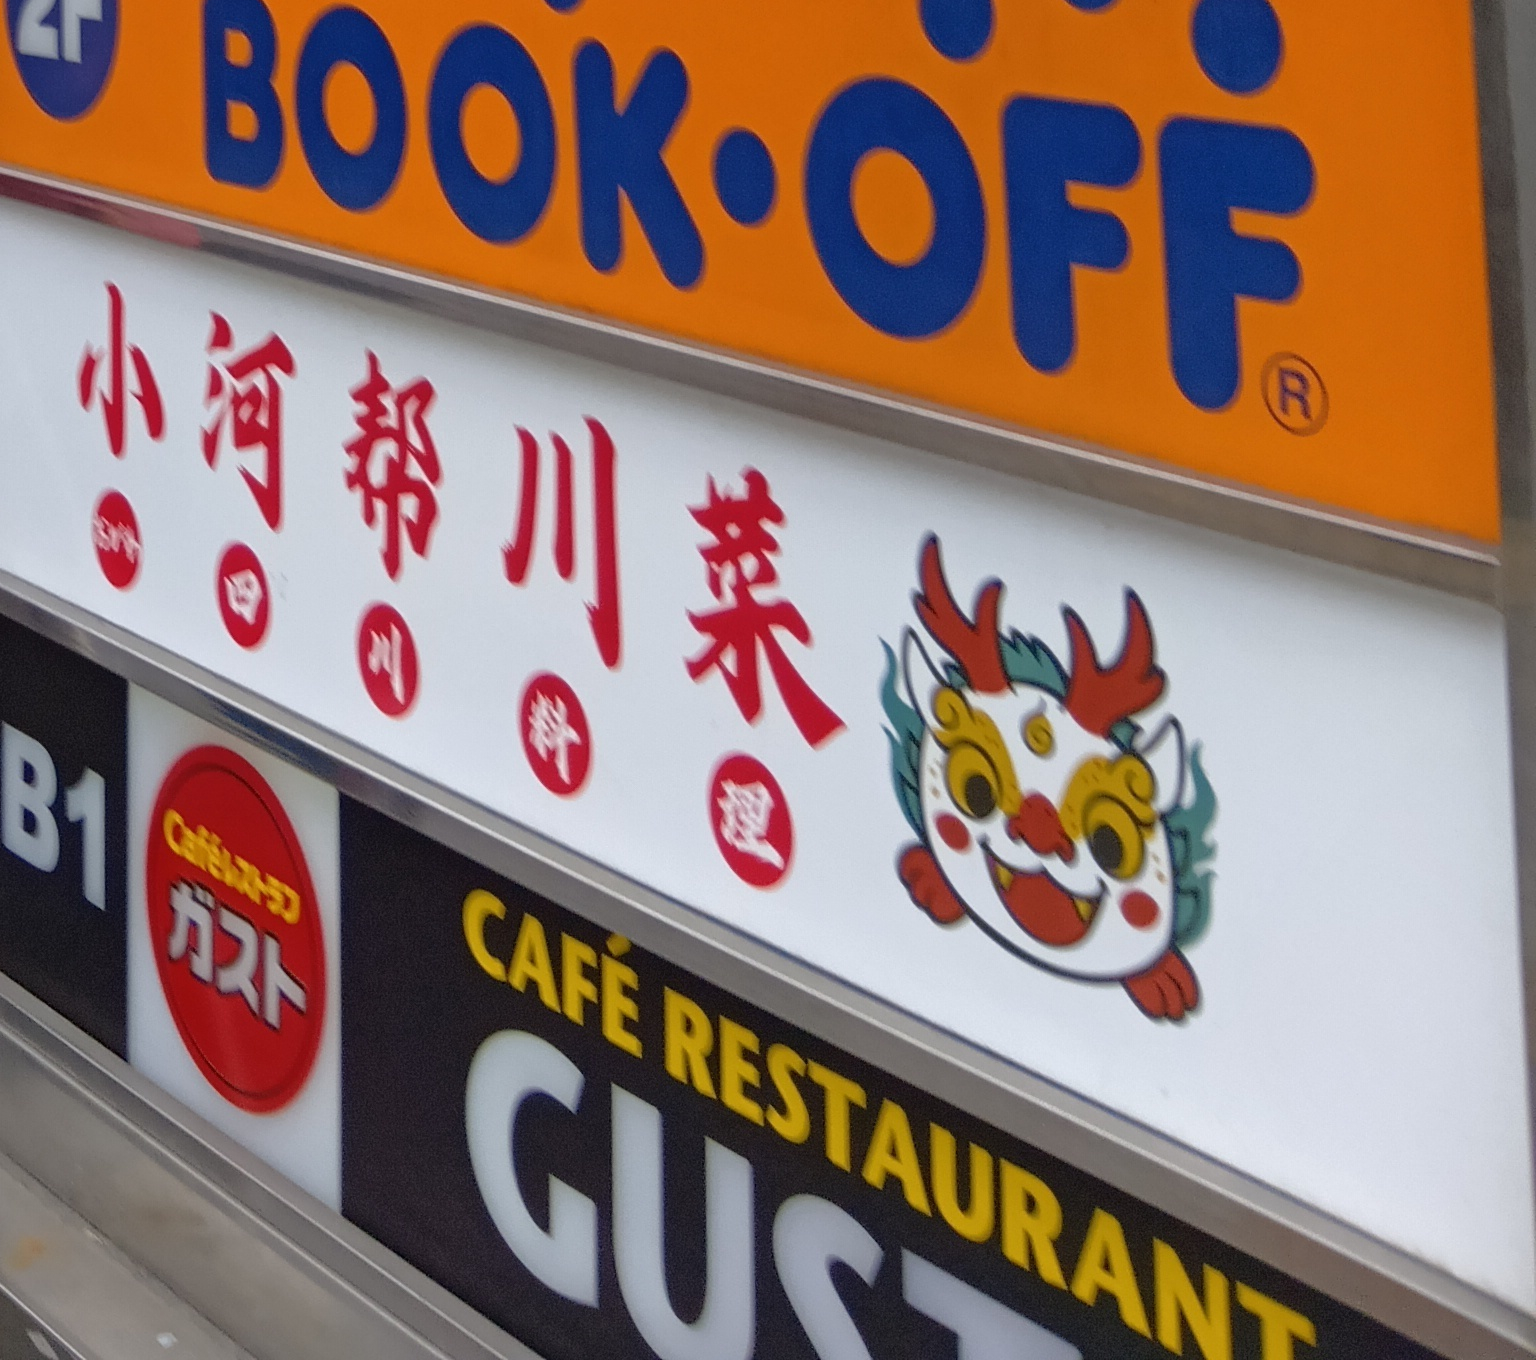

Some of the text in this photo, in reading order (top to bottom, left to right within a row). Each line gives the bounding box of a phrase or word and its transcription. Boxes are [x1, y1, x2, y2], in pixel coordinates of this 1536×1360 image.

[76, 280, 848, 751] 小河帮川菜
[0, 719, 108, 913] B1
[168, 876, 307, 1033] ガスト
[463, 887, 1318, 1360] CAFÉ RESTAURANT
